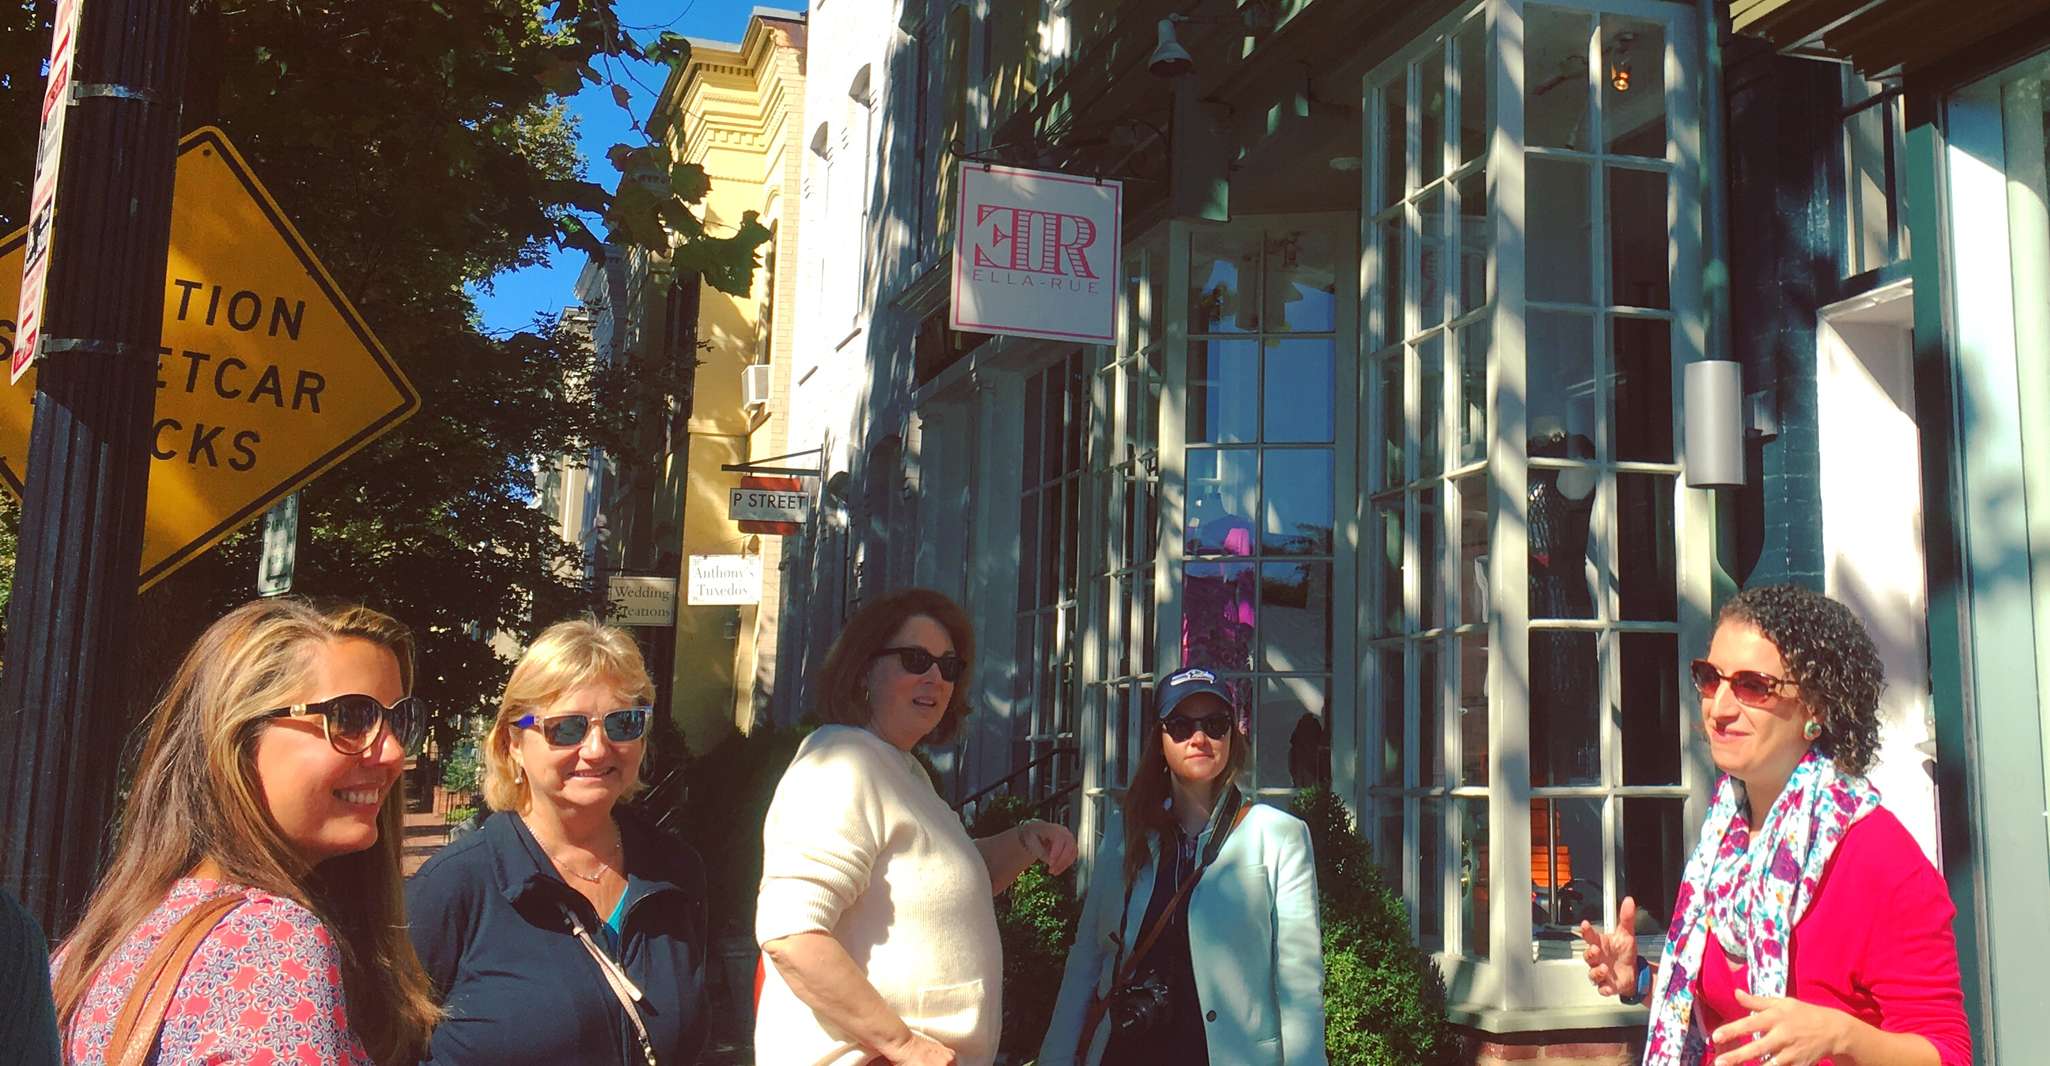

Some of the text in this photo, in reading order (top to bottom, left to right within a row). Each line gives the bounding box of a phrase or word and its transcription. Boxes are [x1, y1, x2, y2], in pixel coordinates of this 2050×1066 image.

[973, 269, 1098, 294] ELLA-RUE
[175, 279, 305, 340] TION
[152, 418, 261, 471] CKS
[733, 493, 806, 510] P STREET
[696, 565, 755, 579] Anthony's
[615, 586, 670, 601] Wedding
[697, 583, 748, 596] Tuxedos
